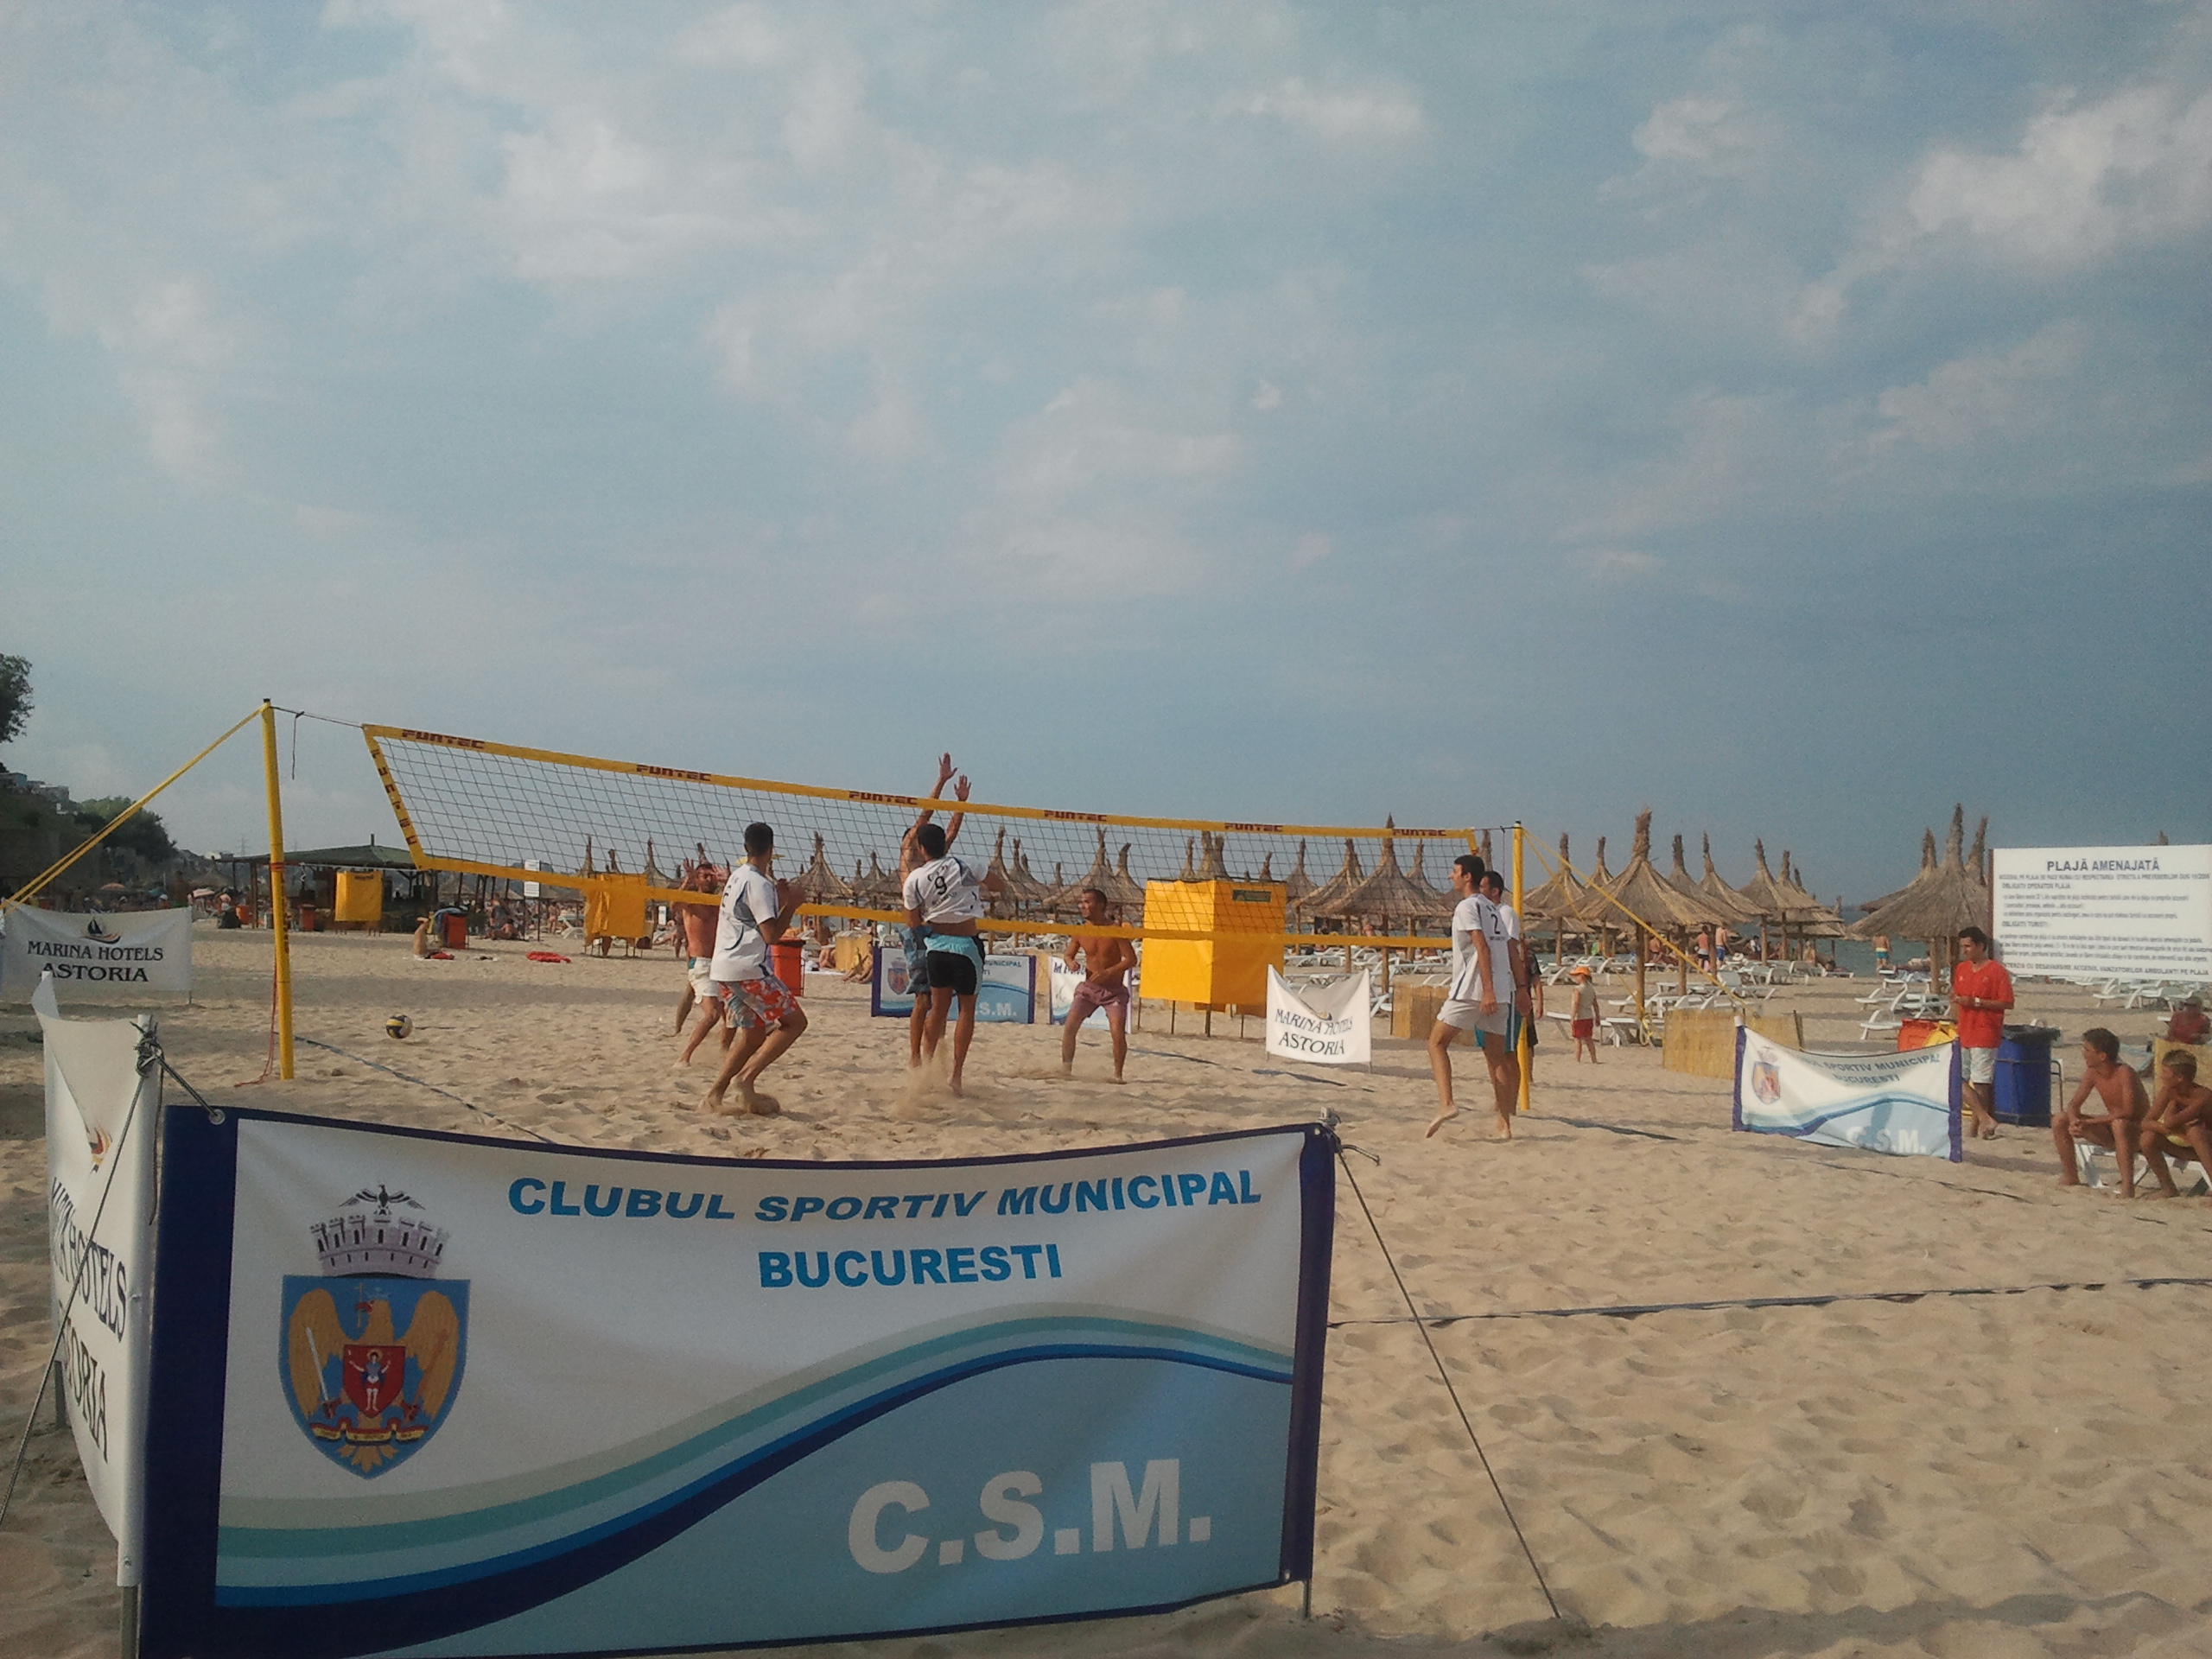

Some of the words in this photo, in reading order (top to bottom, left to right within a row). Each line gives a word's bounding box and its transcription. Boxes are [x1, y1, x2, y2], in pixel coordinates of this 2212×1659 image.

[934, 875, 948, 895] 9
[1491, 913, 1501, 934] 2
[28, 940, 92, 960] MARINA
[98, 946, 164, 961] HOTELS
[38, 962, 149, 982] ASTORIA
[1274, 1007, 1322, 1034] MARINA
[1278, 1031, 1345, 1055] ASTORIA
[1823, 1061, 1872, 1072] SPORTIV
[507, 1177, 735, 1220] CLUBUL
[753, 1191, 988, 1223] SPORTIV
[996, 1169, 1262, 1216] MUNICIPAL
[757, 1243, 1063, 1288] BUCURESTI
[848, 1458, 1211, 1574] C.S.M.
